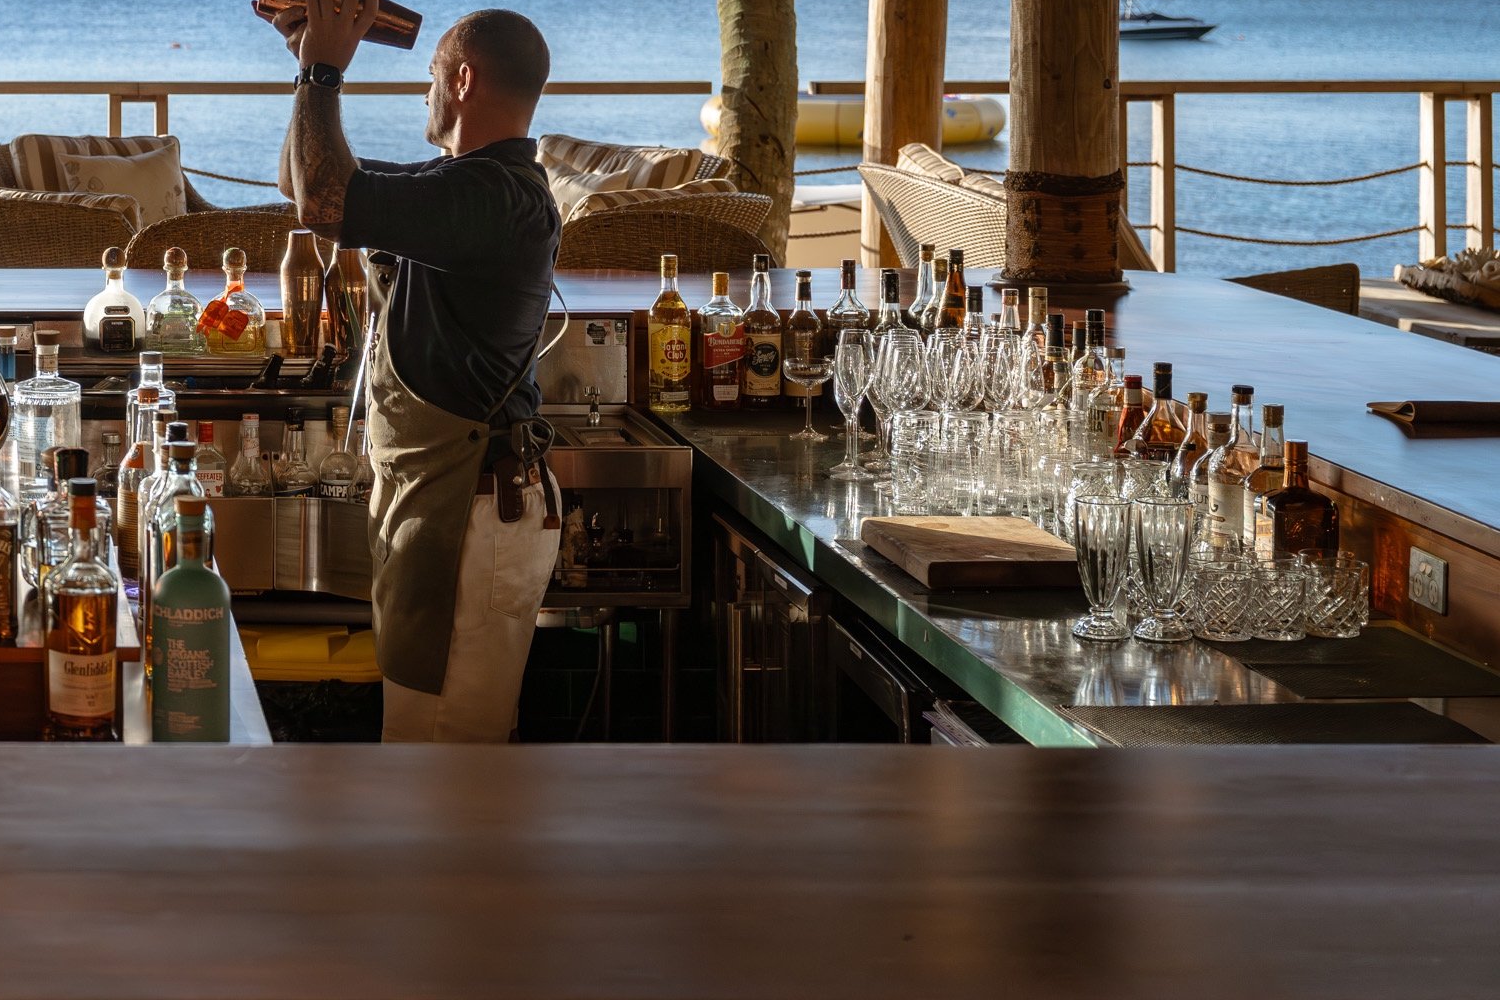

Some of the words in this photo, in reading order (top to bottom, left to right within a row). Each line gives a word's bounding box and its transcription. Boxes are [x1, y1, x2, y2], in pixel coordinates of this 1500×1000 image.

[667, 351, 684, 360] Club
[196, 472, 223, 481] EEFEATER
[167, 639, 185, 649] THE
